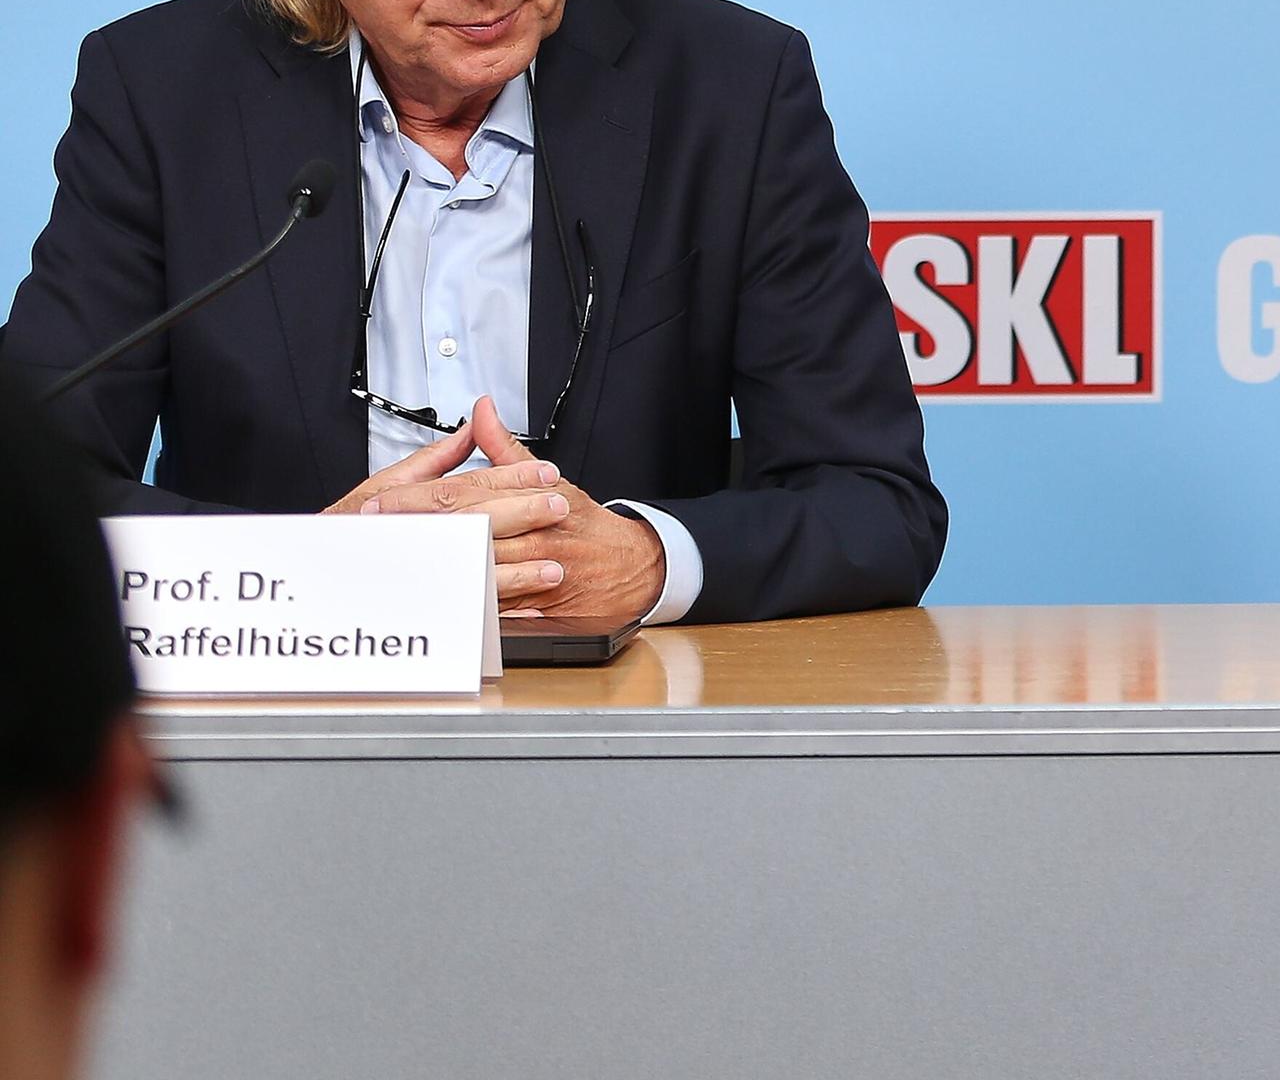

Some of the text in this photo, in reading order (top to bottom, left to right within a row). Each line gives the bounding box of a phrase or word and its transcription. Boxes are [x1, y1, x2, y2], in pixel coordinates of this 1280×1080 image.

[882, 233, 1142, 386] SKL
[121, 570, 296, 602] Prof. Dr.
[123, 625, 431, 658] Raffelhüschen
